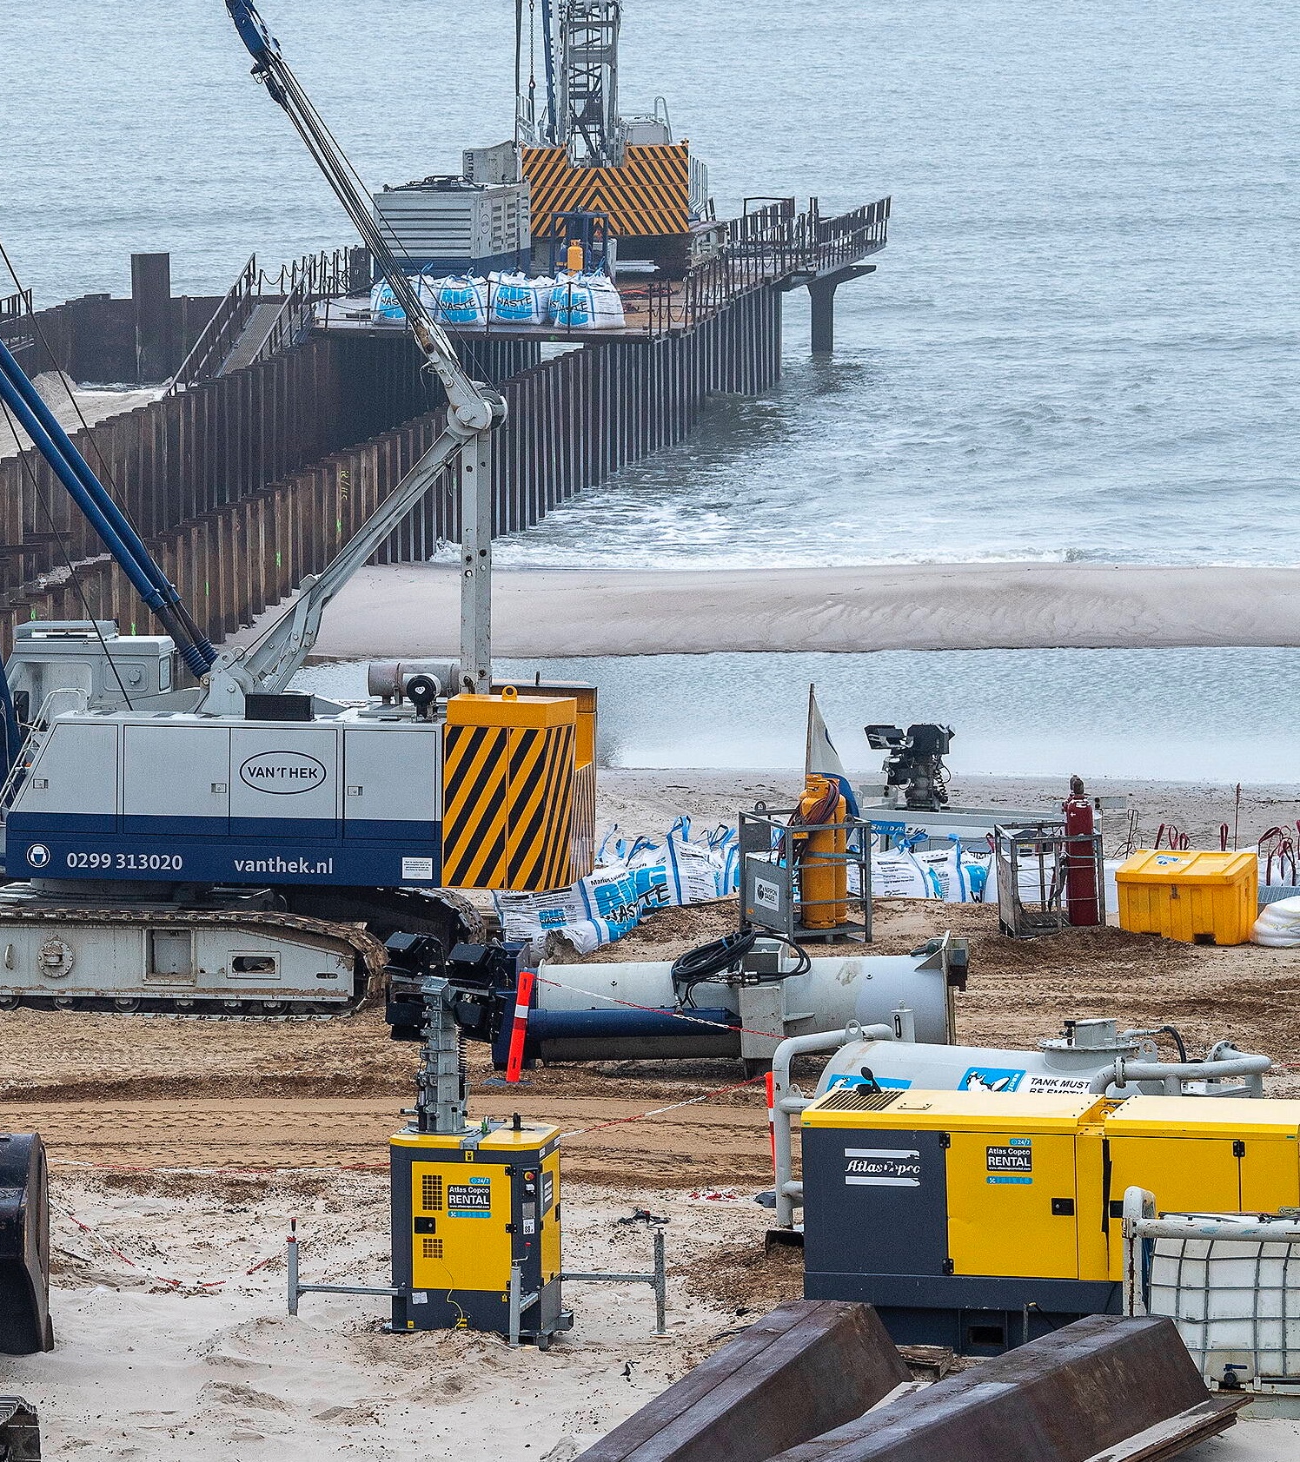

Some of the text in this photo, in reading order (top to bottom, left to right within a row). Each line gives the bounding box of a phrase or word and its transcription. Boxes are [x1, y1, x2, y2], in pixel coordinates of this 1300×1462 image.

[440, 297, 476, 311] WASTE
[496, 295, 532, 307] WASTE
[247, 766, 275, 778] VAN
[289, 767, 318, 779] HEK
[66, 852, 183, 870] 0299 313020
[234, 856, 333, 874] vanthek.nl
[1031, 1077, 1091, 1090] TANK MUST
[987, 1147, 1031, 1157] Atlas Copco
[844, 1159, 883, 1173] Atlas
[988, 1156, 1031, 1167] RENTAL
[448, 1186, 490, 1195] Atlas Copco
[448, 1195, 490, 1205] RENTAL
